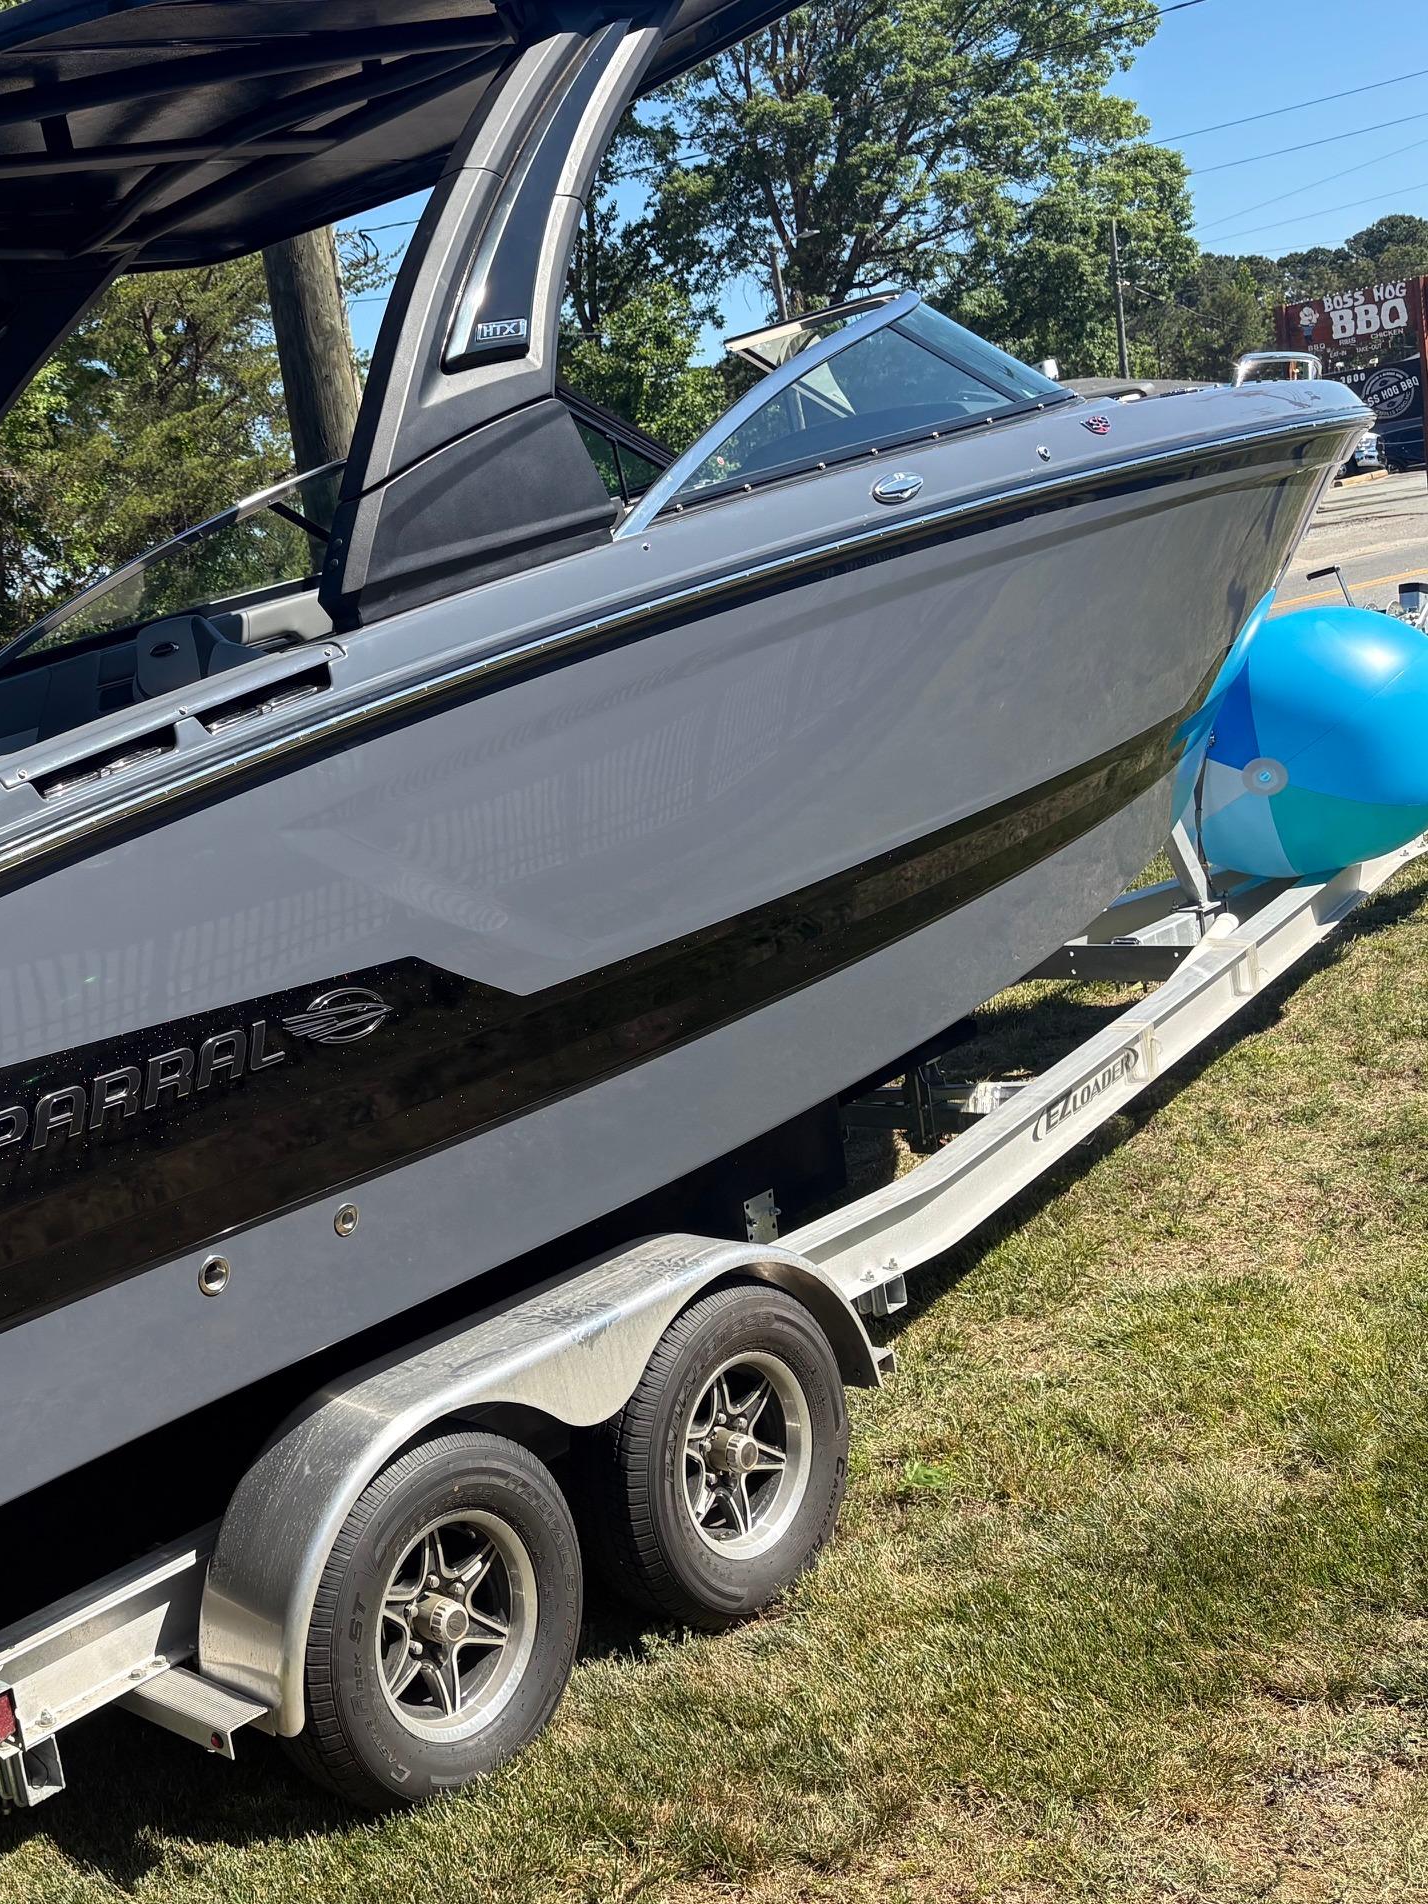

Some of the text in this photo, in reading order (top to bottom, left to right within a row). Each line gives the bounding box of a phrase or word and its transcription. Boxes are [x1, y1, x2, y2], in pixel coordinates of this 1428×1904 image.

[1322, 282, 1407, 313] BOSS HOG
[1330, 298, 1408, 340] BBQ
[1370, 328, 1404, 339] CHICKEN
[1380, 385, 1400, 400] HOG
[1400, 375, 1420, 392] BBQ
